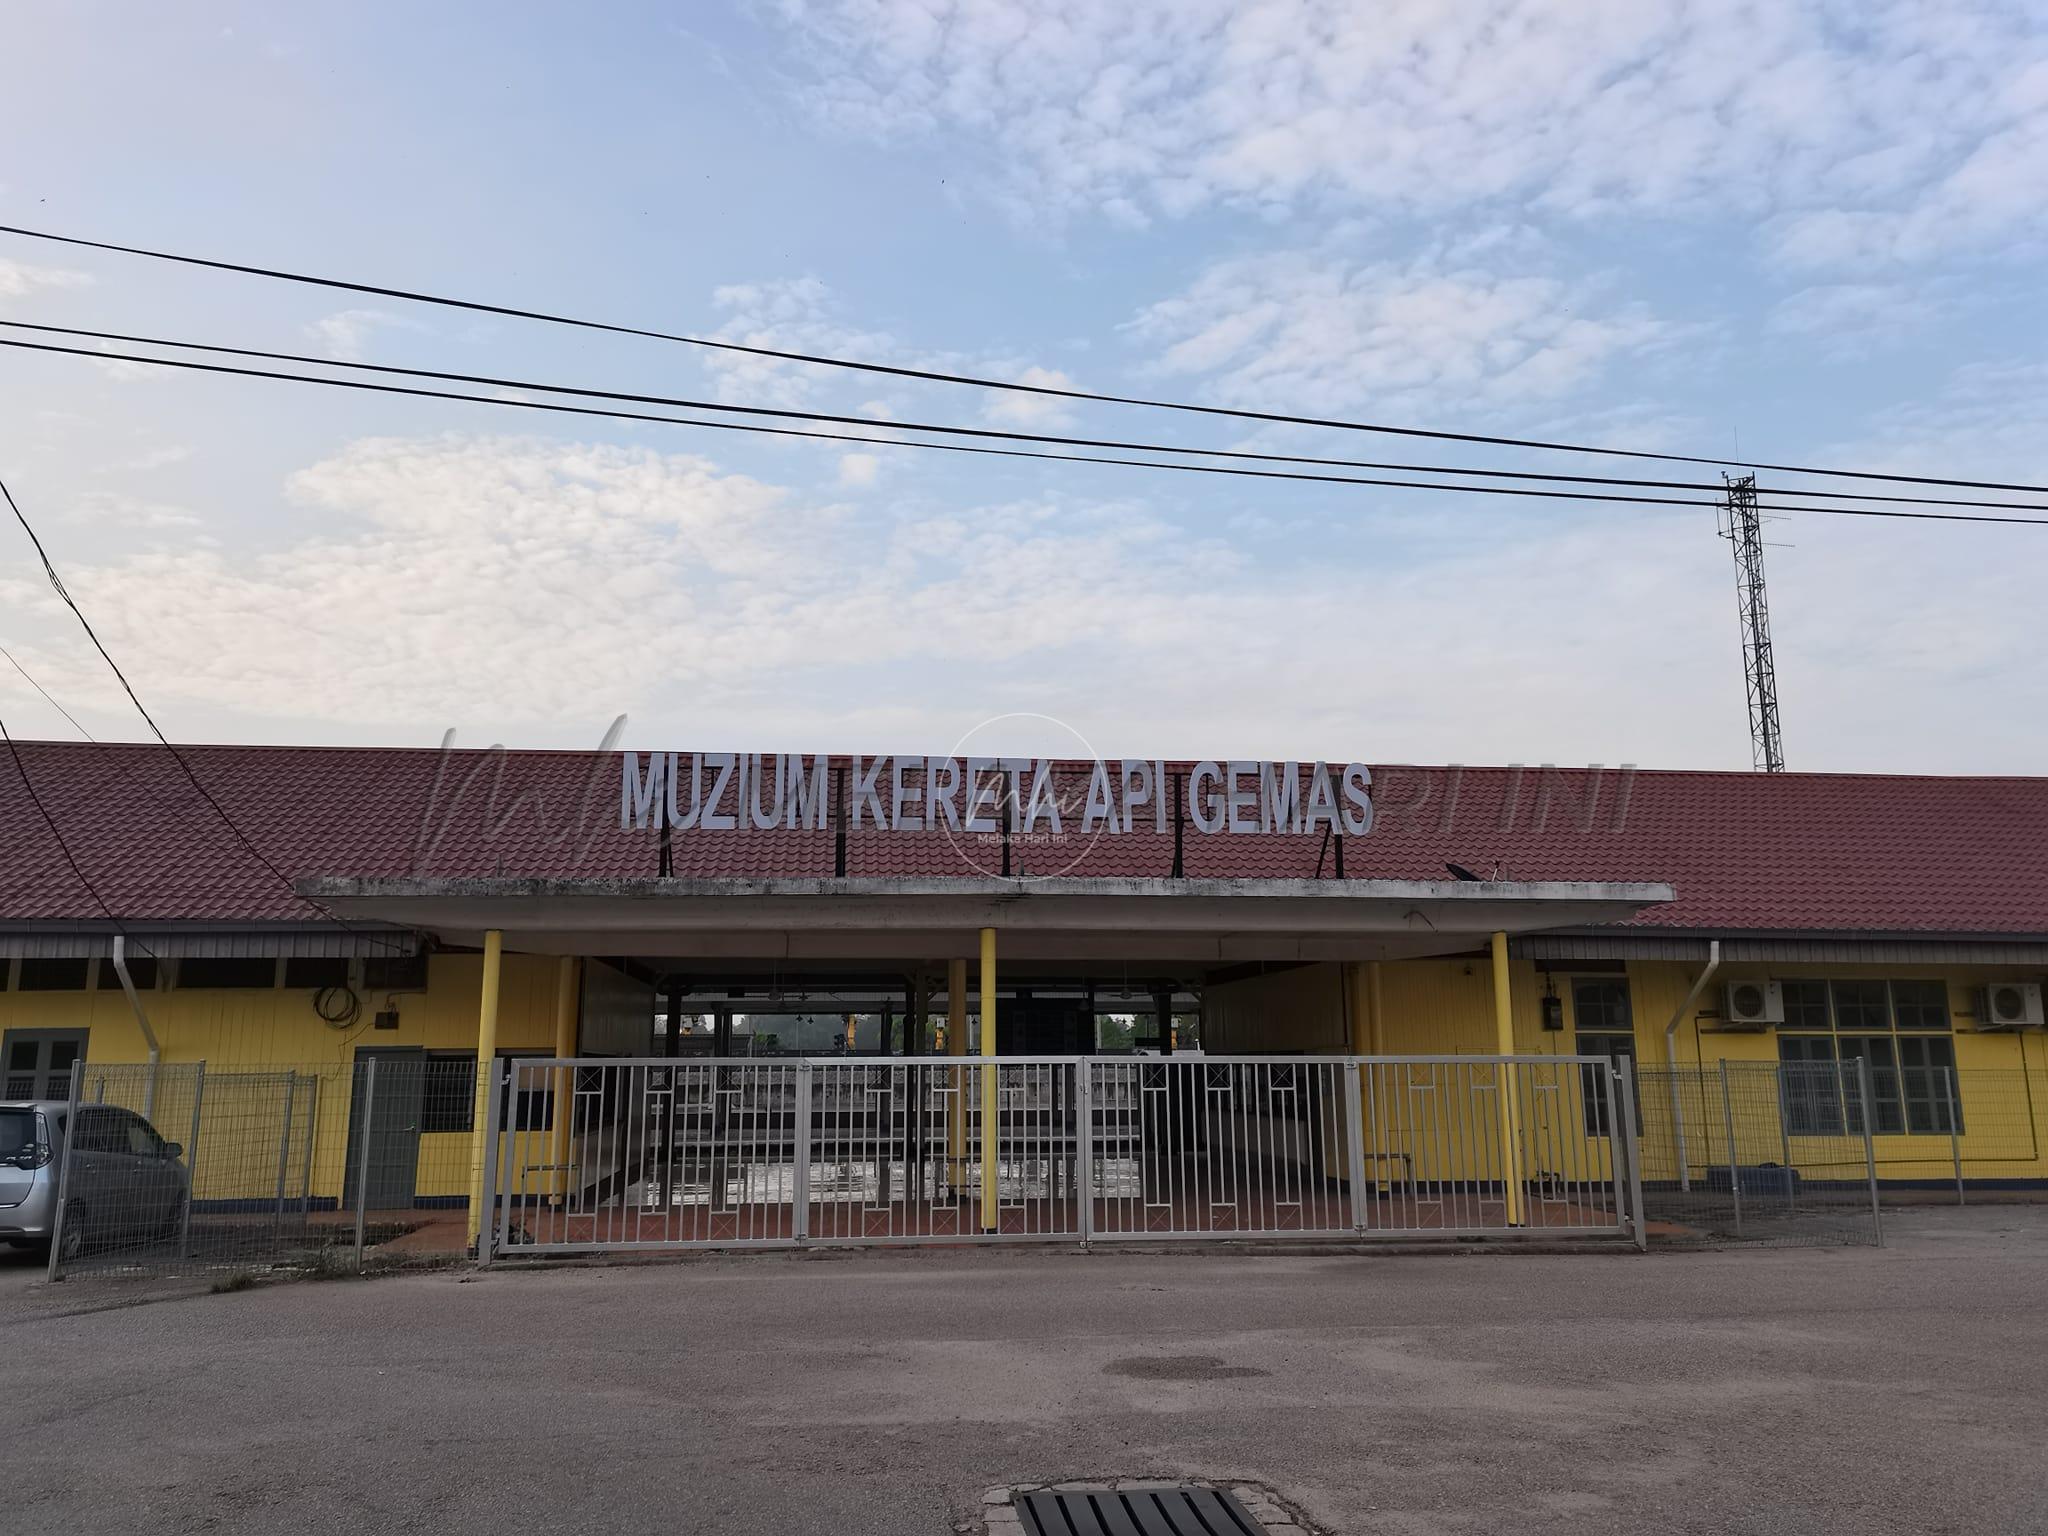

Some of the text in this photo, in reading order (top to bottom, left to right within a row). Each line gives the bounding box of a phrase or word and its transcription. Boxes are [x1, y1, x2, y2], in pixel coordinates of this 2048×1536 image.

[621, 752, 1374, 836] MUZIUM KERETA API GEMAS
